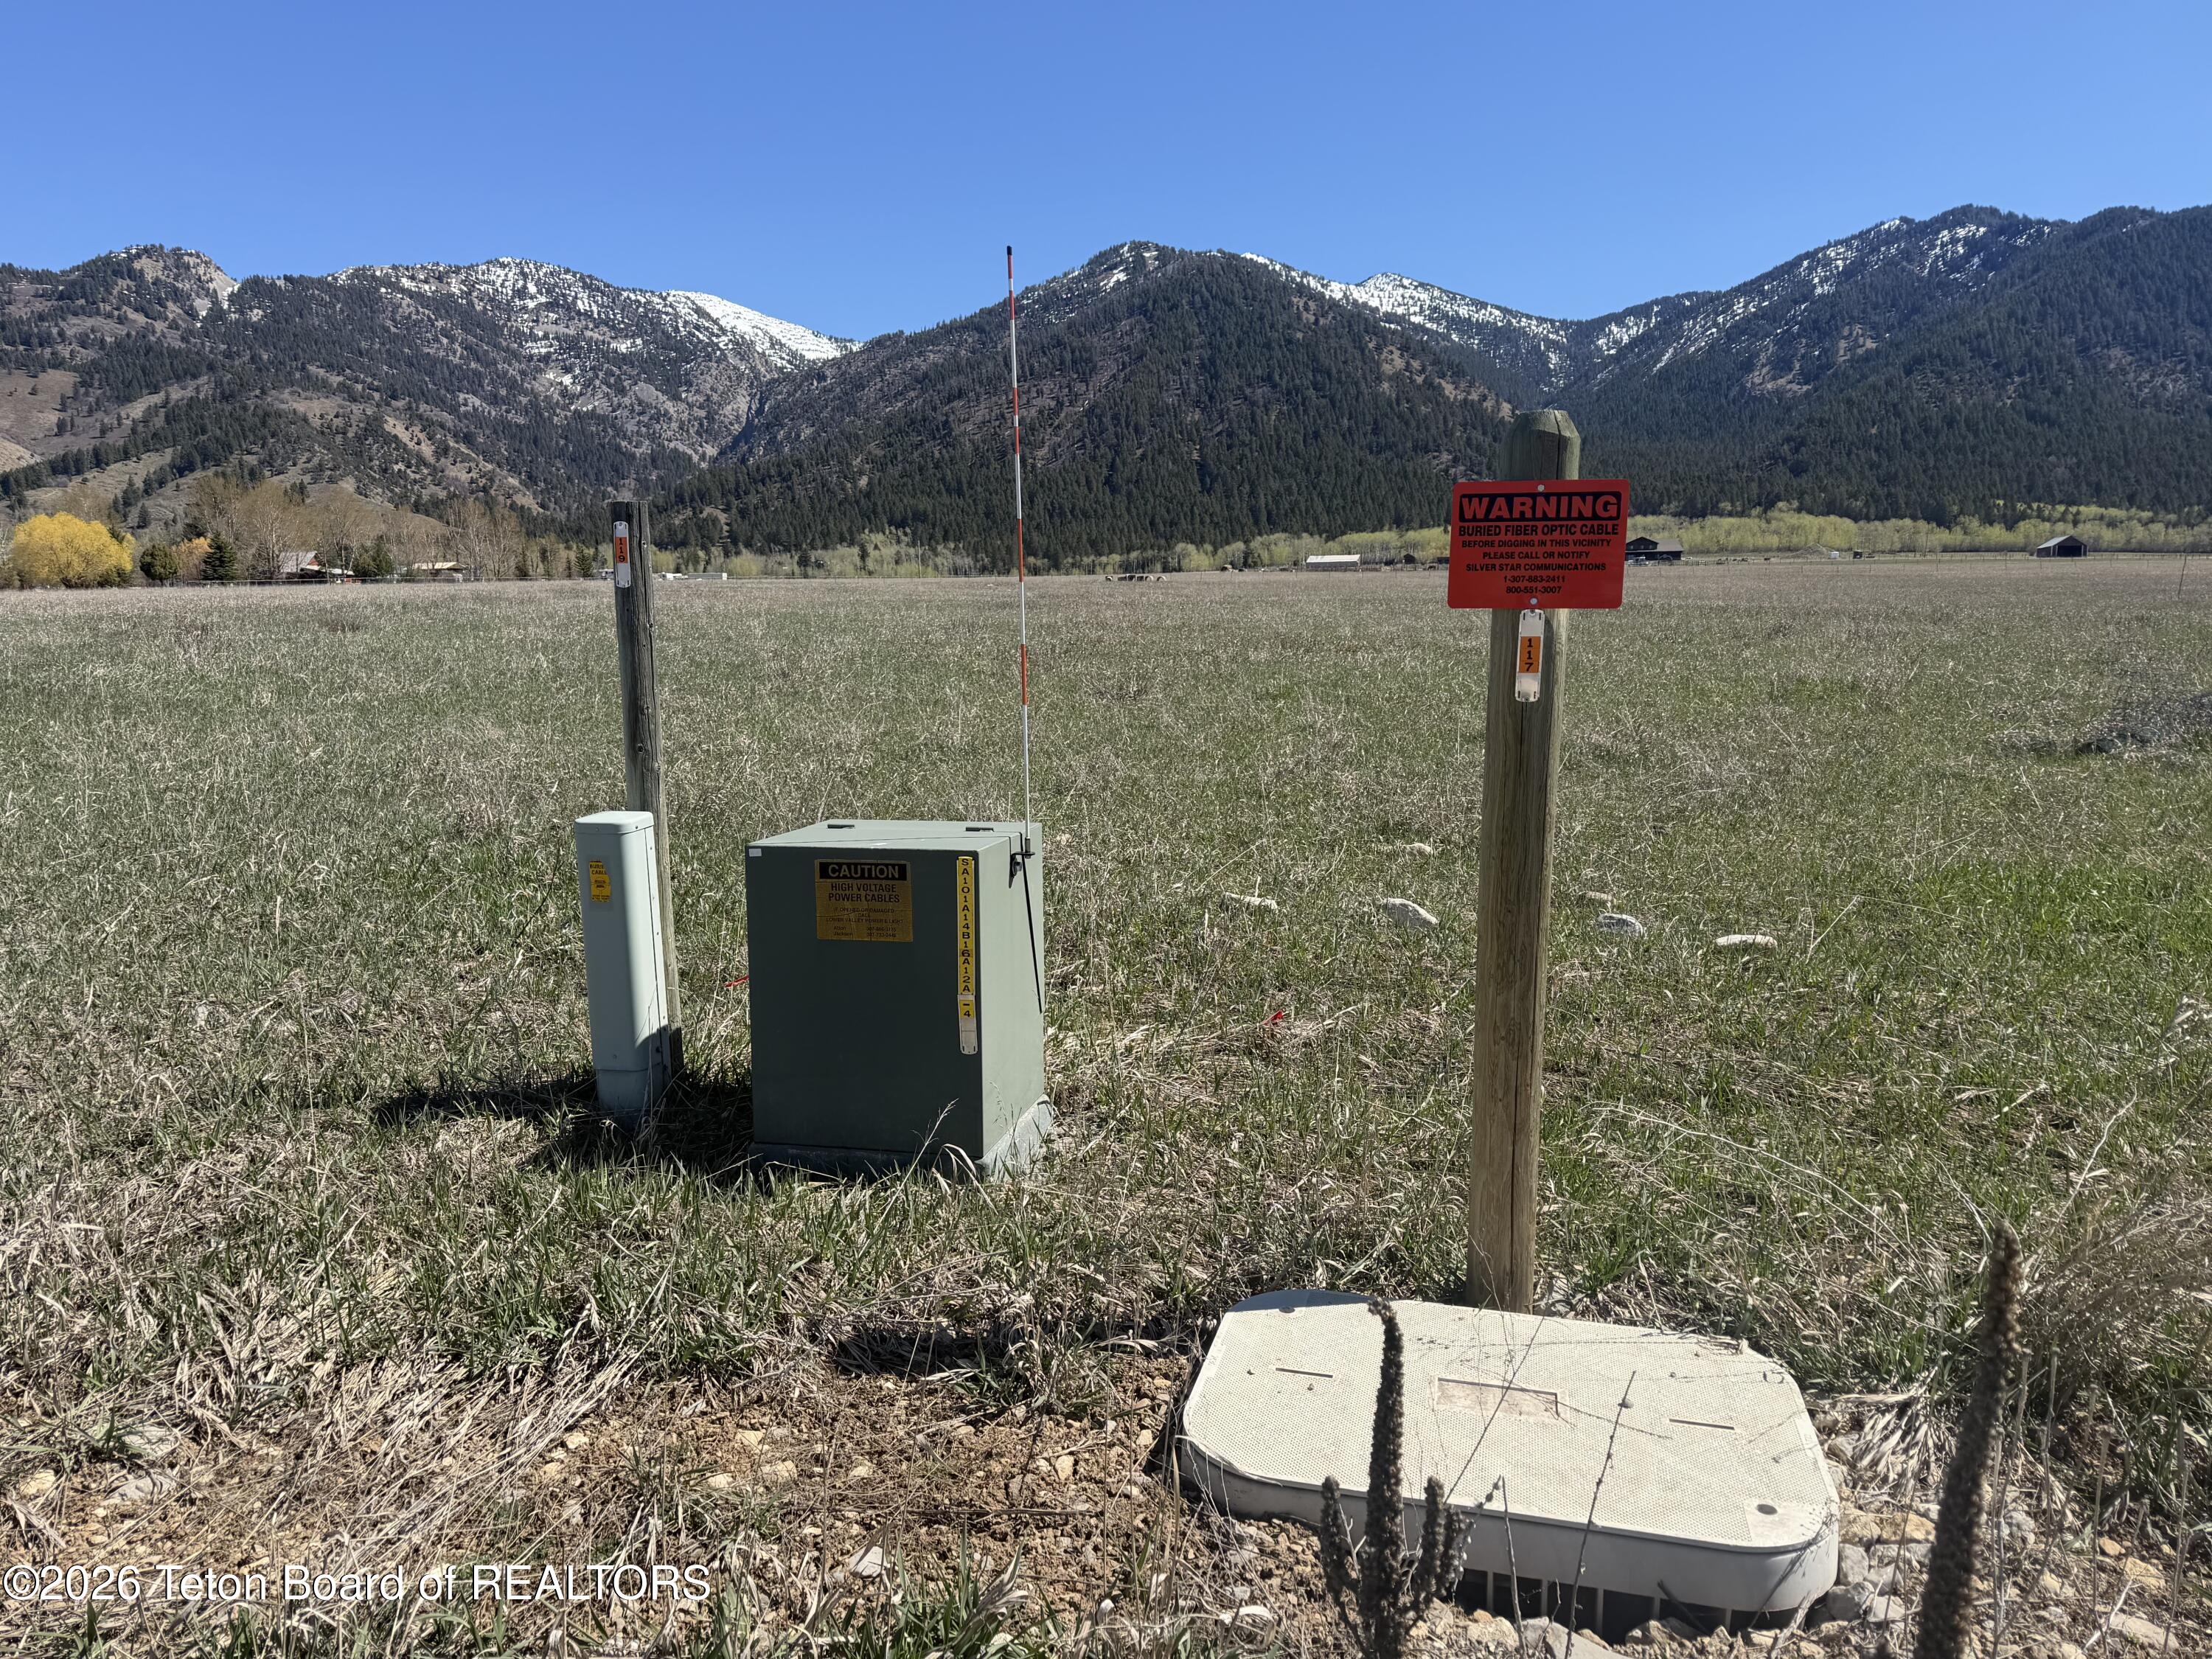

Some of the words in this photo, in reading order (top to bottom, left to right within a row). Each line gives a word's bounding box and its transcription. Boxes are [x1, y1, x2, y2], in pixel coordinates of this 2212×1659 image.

[1461, 495, 1618, 519] WARNING
[1458, 524, 1501, 537] BURIED
[1504, 524, 1538, 536] FIBER
[1542, 524, 1576, 535] OPTIC
[1579, 524, 1618, 535] CABLE
[1462, 540, 1496, 548] BEFORE
[1498, 540, 1534, 548] DIGGING
[1550, 539, 1570, 547] THIS
[1572, 538, 1612, 547] VICINITY
[1483, 552, 1516, 560] PLEASE
[1517, 552, 1540, 560] CALL
[1543, 552, 1555, 560] OR
[1557, 551, 1590, 559] NOTIFY
[1466, 563, 1496, 571] SILVER
[1498, 563, 1521, 571] STAR
[1523, 563, 1607, 571] COMMUNICATIONS
[1503, 575, 1565, 583] 1-307-883-2411
[1525, 638, 1534, 672] 117
[828, 864, 899, 878] CAUTION
[831, 883, 853, 891] HIGH
[855, 883, 897, 892] VOLTAGE
[829, 893, 862, 902] POWER
[865, 894, 900, 903] CABLES
